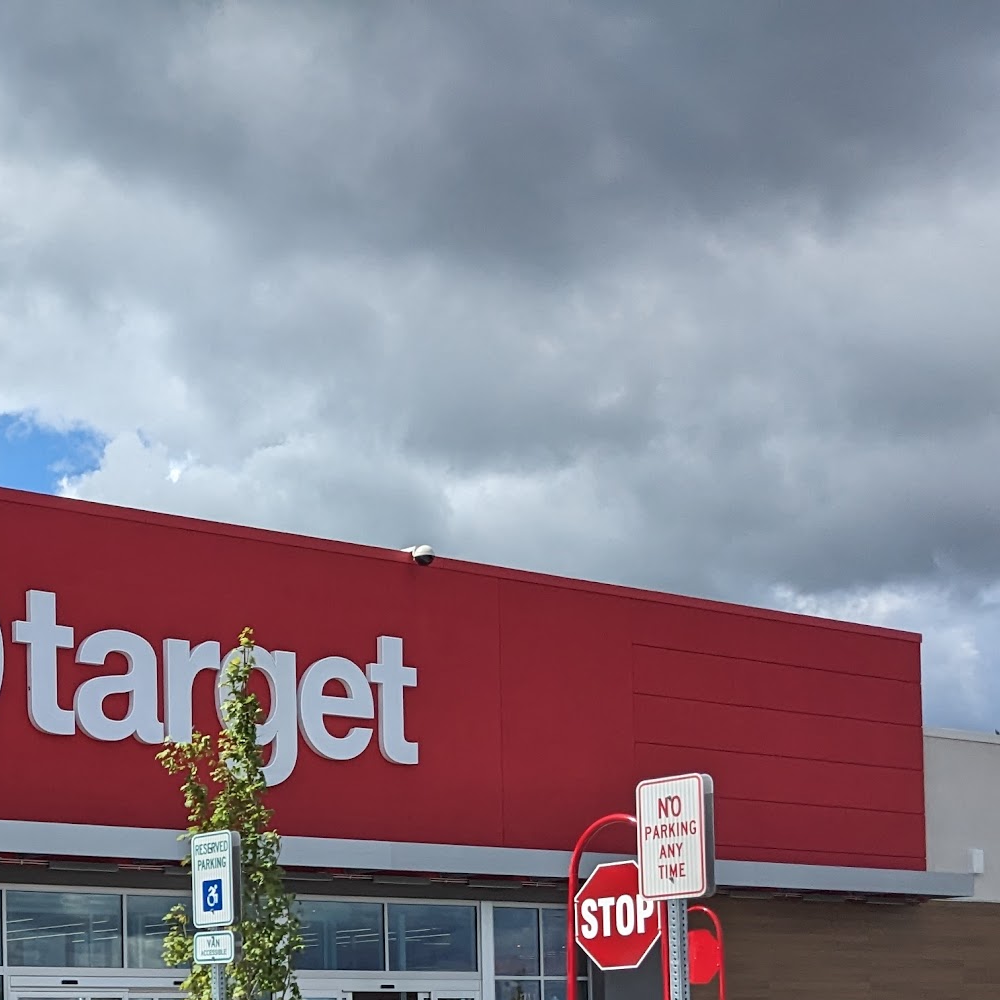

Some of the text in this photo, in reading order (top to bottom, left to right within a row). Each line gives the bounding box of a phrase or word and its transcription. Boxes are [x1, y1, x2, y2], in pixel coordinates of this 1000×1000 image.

[12, 589, 419, 788] target
[658, 795, 682, 819] NO
[645, 820, 697, 840] PARKING
[195, 840, 228, 855] RESERVED
[659, 843, 683, 859] ANY
[197, 856, 227, 871] PARKING
[658, 863, 686, 878] TIME
[581, 894, 654, 939] STOP
[207, 938, 220, 948] VAN
[201, 948, 227, 956] ACCESSIBLE
